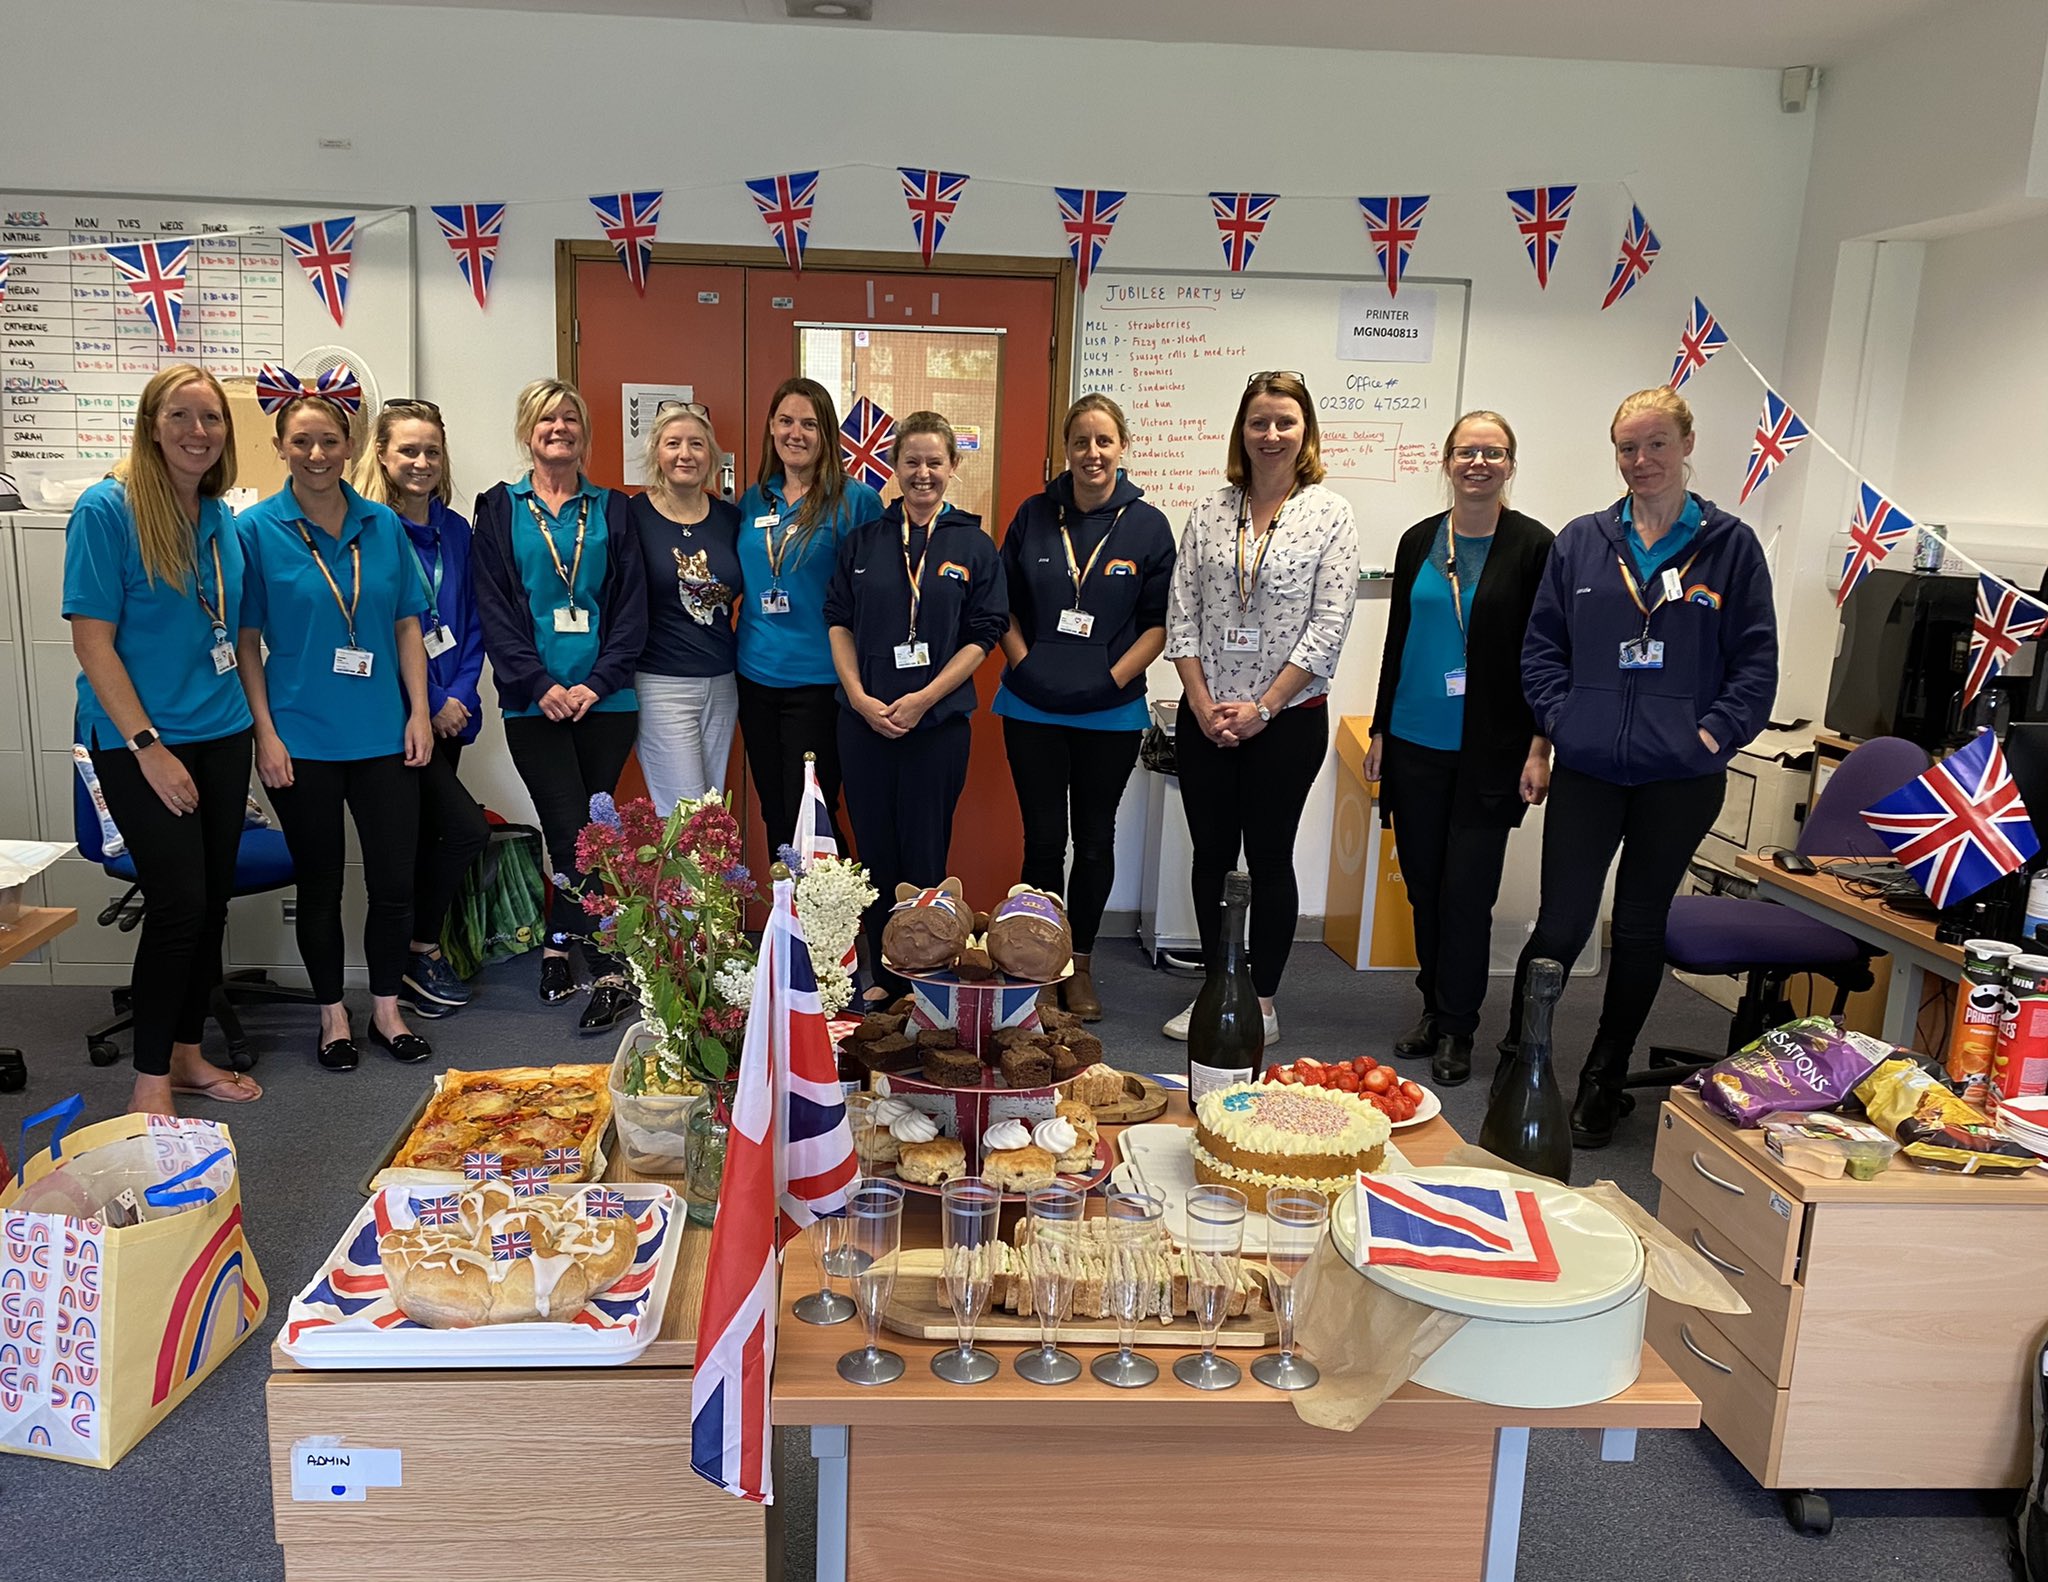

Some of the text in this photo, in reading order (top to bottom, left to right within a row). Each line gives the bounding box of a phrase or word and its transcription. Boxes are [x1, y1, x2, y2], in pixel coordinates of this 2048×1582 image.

[8, 211, 46, 221] NURSES
[75, 218, 228, 232] MON TUES WEDS THURS
[3, 232, 42, 242] NATALIE
[7, 286, 39, 295] HELEN
[1106, 285, 1221, 302] JUBILEE PARTY
[5, 304, 38, 312] CLAIRE
[1366, 309, 1409, 321] PRINTER
[4, 322, 48, 332] CATHERINE
[1086, 321, 1108, 331] MEL
[1128, 319, 1191, 330] Strawberries
[1353, 326, 1419, 339] MGN040813
[8, 339, 35, 347] ANNA
[1132, 338, 1157, 349] Fizzy
[1084, 352, 1108, 362] LUCY
[1130, 352, 1163, 365] Sausage
[1168, 349, 1187, 358] rolls
[1083, 368, 1114, 377] SARAH
[1133, 367, 1173, 376] Brownies
[1138, 383, 1185, 392] Sandwiches
[1346, 374, 1383, 392] Office
[11, 395, 39, 405] KELLY
[1132, 400, 1149, 409] Iced
[1155, 400, 1172, 408] bun
[1320, 396, 1427, 411] 02380 475221
[13, 414, 36, 425] LUCY
[14, 432, 43, 442] SARAH
[1353, 432, 1385, 444] Delivery
[2012, 976, 2034, 990] WIN
[307, 1455, 350, 1466] ADMIN
